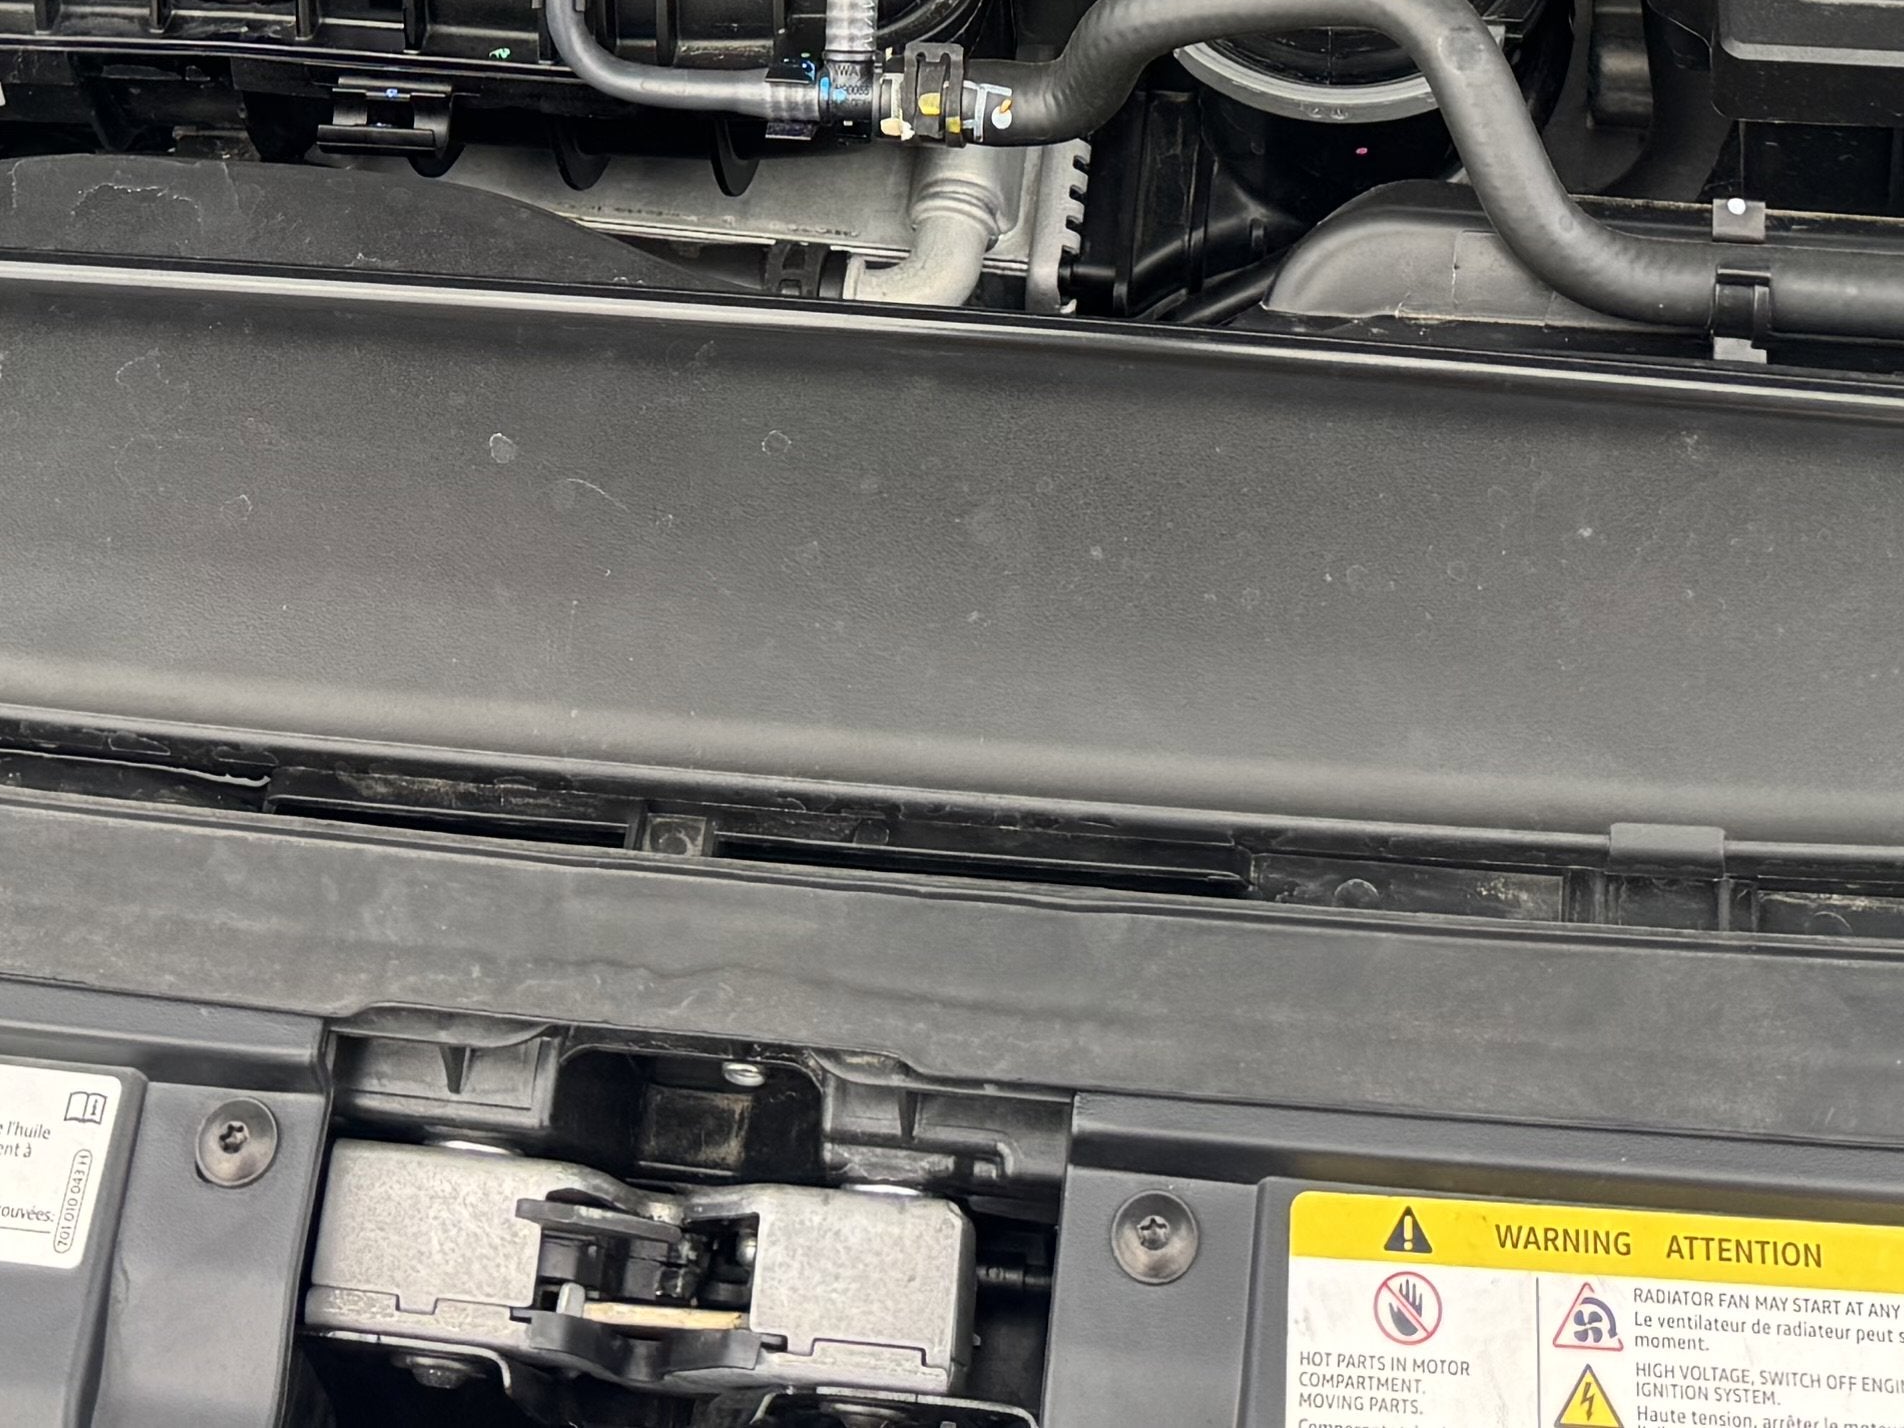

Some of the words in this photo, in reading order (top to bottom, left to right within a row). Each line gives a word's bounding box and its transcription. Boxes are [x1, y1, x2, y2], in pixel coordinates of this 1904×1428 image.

[7, 1120, 51, 1140] l'huile
[23, 1143, 33, 1159] à
[70, 1169, 86, 1195] 043
[64, 1197, 78, 1222] 010
[57, 1226, 72, 1247] 701
[1495, 1223, 1632, 1256] WARNING
[1666, 1234, 1822, 1268] ATTENTION
[1633, 1287, 1714, 1308] RADIATOR
[1718, 1293, 1750, 1310] FAN
[1754, 1296, 1789, 1313] MAY
[1792, 1297, 1841, 1315] START
[1845, 1301, 1864, 1317] AT
[1868, 1303, 1900, 1320] ANY
[1634, 1311, 1653, 1328] Le
[1657, 1313, 1746, 1334] ventilateur
[1751, 1318, 1771, 1336] de
[1776, 1320, 1851, 1340] radiateur
[1856, 1327, 1894, 1344] peut
[1634, 1333, 1710, 1352] moment.
[1299, 1351, 1332, 1368] HOT
[1337, 1353, 1387, 1372] PARTS
[1391, 1356, 1407, 1372] IN
[1412, 1358, 1471, 1376] MOTOR
[1299, 1371, 1426, 1395] COMPARTMENT.
[1635, 1361, 1675, 1379] HIGH
[1679, 1364, 1756, 1387] VOLTAGE,
[1759, 1370, 1821, 1389] SWITCH
[1826, 1374, 1857, 1392] OFF
[1298, 1392, 1365, 1412] MOVING
[1369, 1396, 1424, 1415] PARTS.
[1636, 1381, 1709, 1401] IGNITION
[1714, 1386, 1782, 1406] SYSTEM.
[1637, 1406, 1687, 1425] Haute
[1691, 1410, 1758, 1428] tension,
